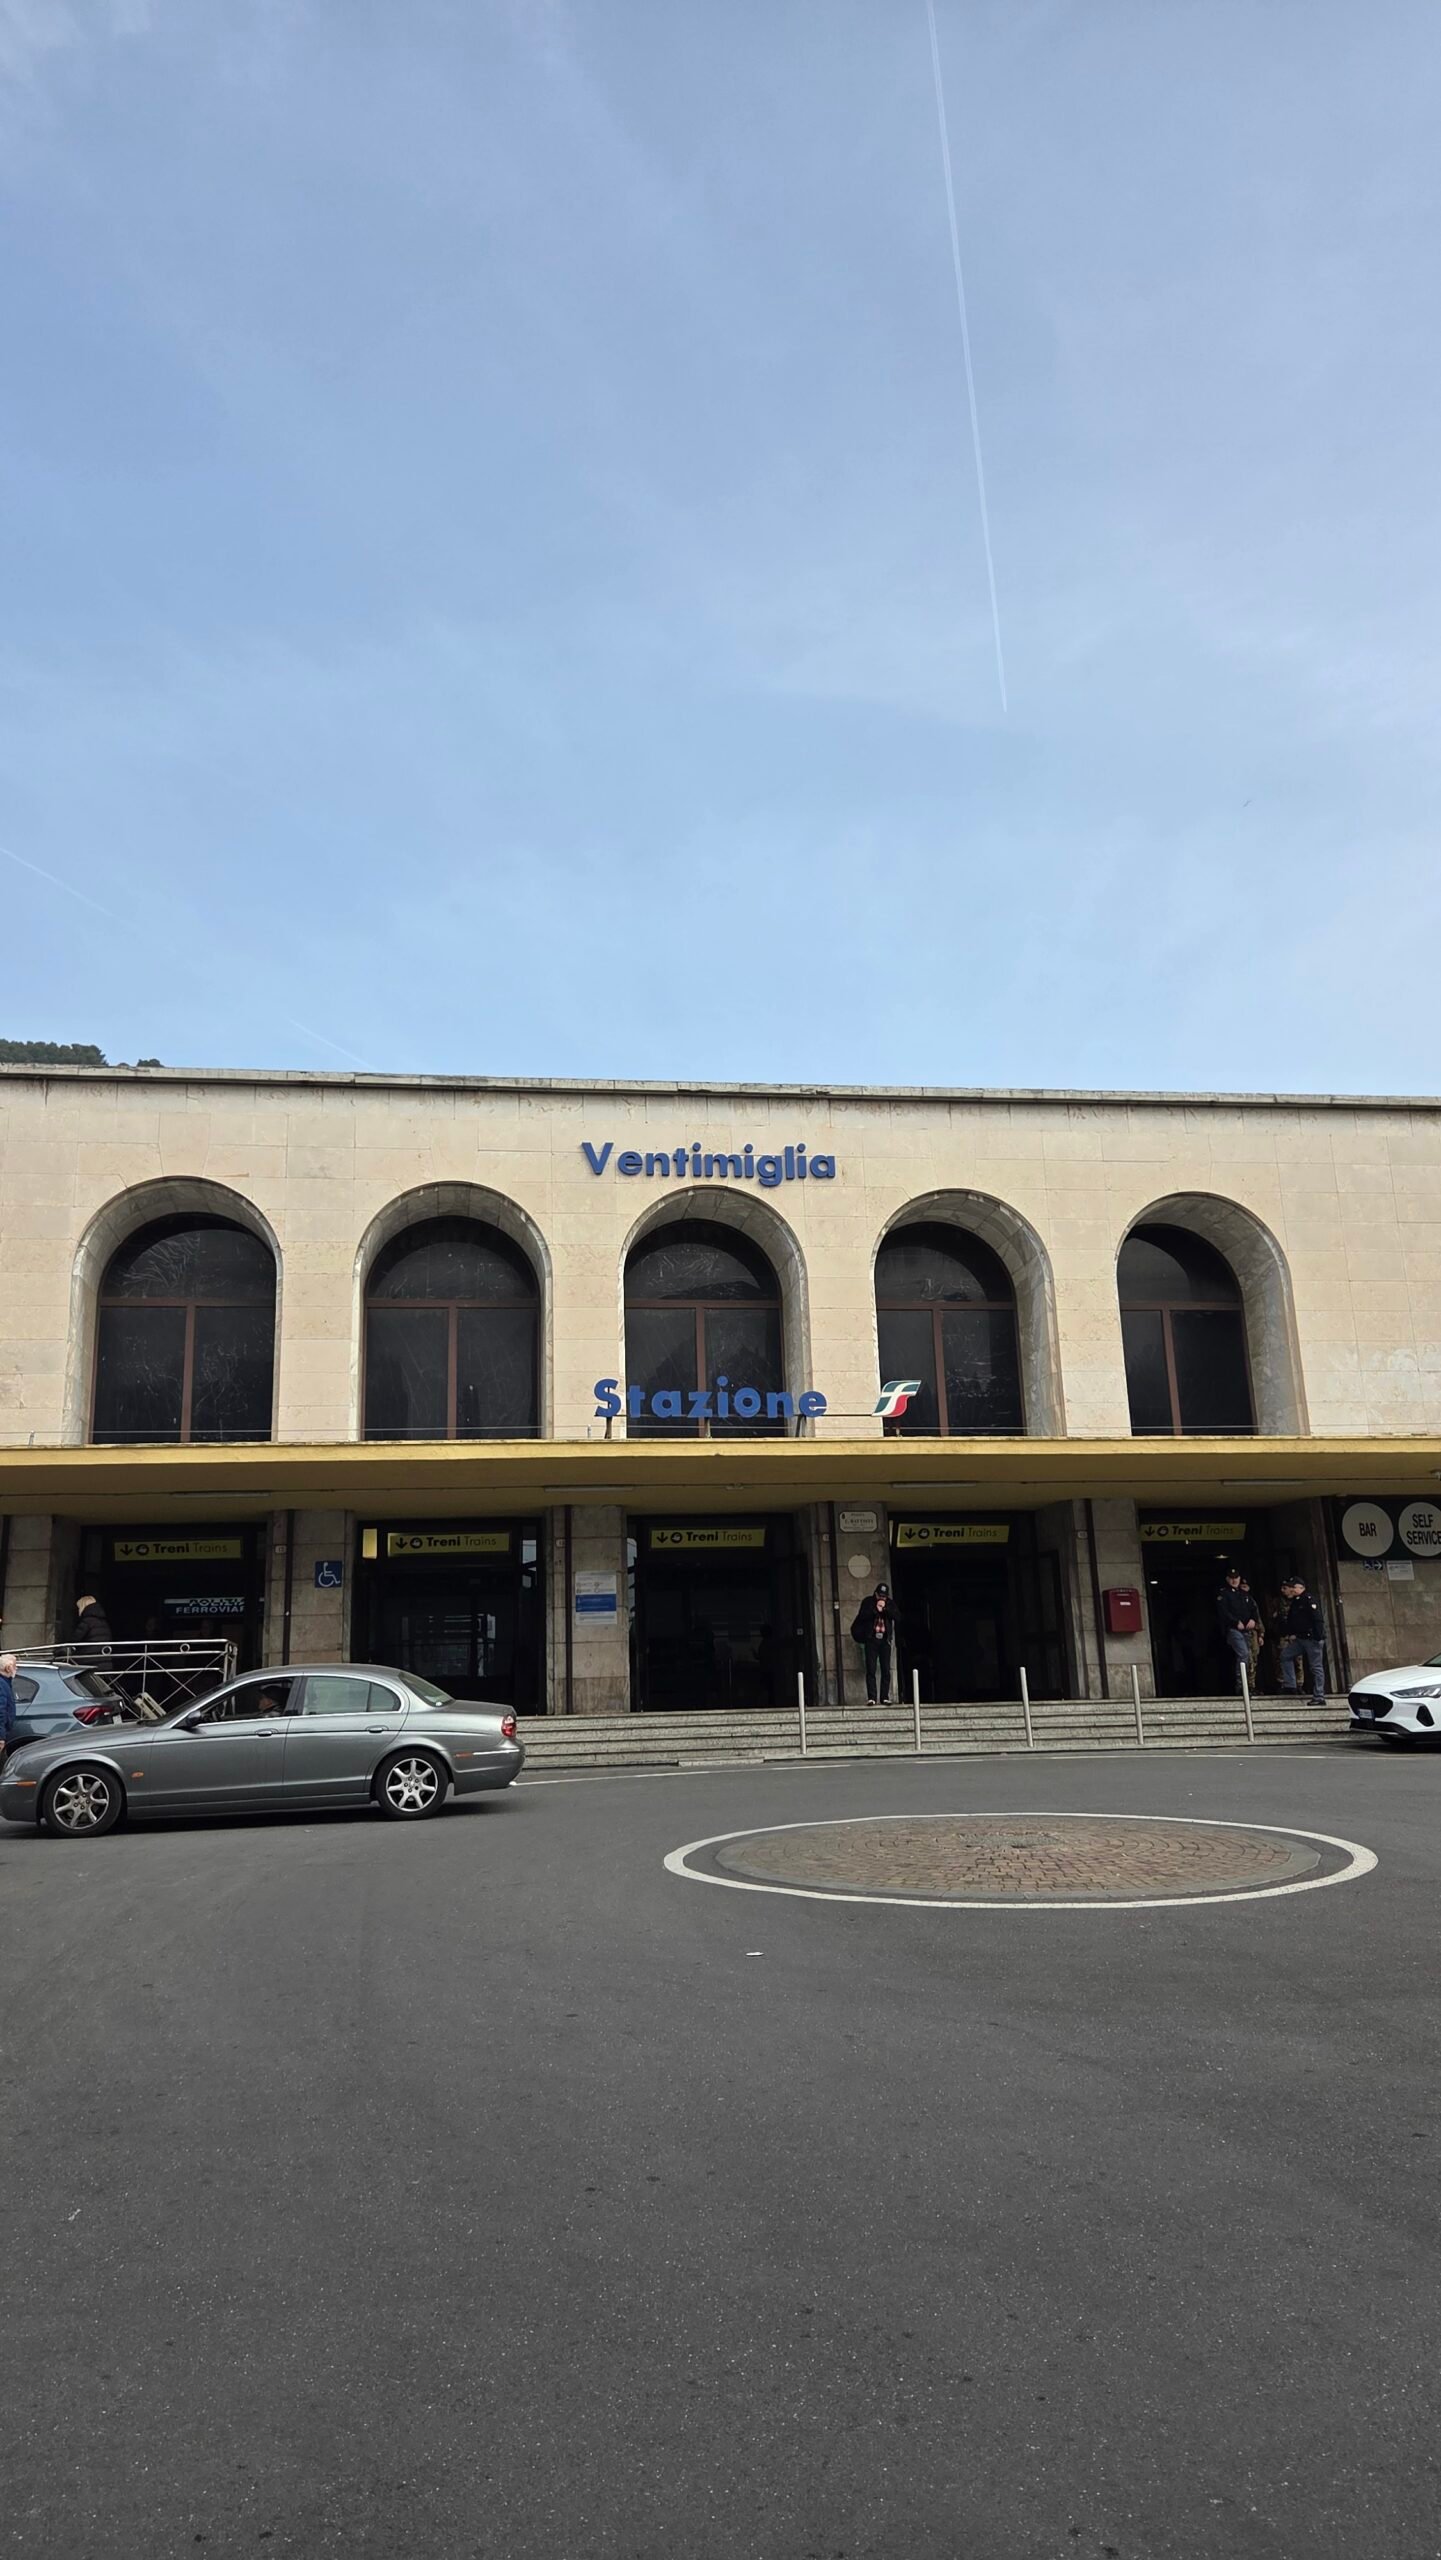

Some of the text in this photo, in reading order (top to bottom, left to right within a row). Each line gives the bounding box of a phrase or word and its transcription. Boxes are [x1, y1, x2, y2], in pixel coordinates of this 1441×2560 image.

[581, 1142, 836, 1187] Ventimiglia
[593, 1376, 828, 1418] Stazione
[1412, 1513, 1434, 1528] SELF
[933, 1527, 997, 1537] Treni Trains
[1172, 1525, 1233, 1535] Treni Trains
[1358, 1522, 1377, 1537] BAR
[426, 1535, 496, 1547] Treni Trains
[686, 1531, 753, 1542] Treni Trains
[1406, 1530, 1441, 1545] SERVICE
[153, 1542, 227, 1554] Treni Trains
